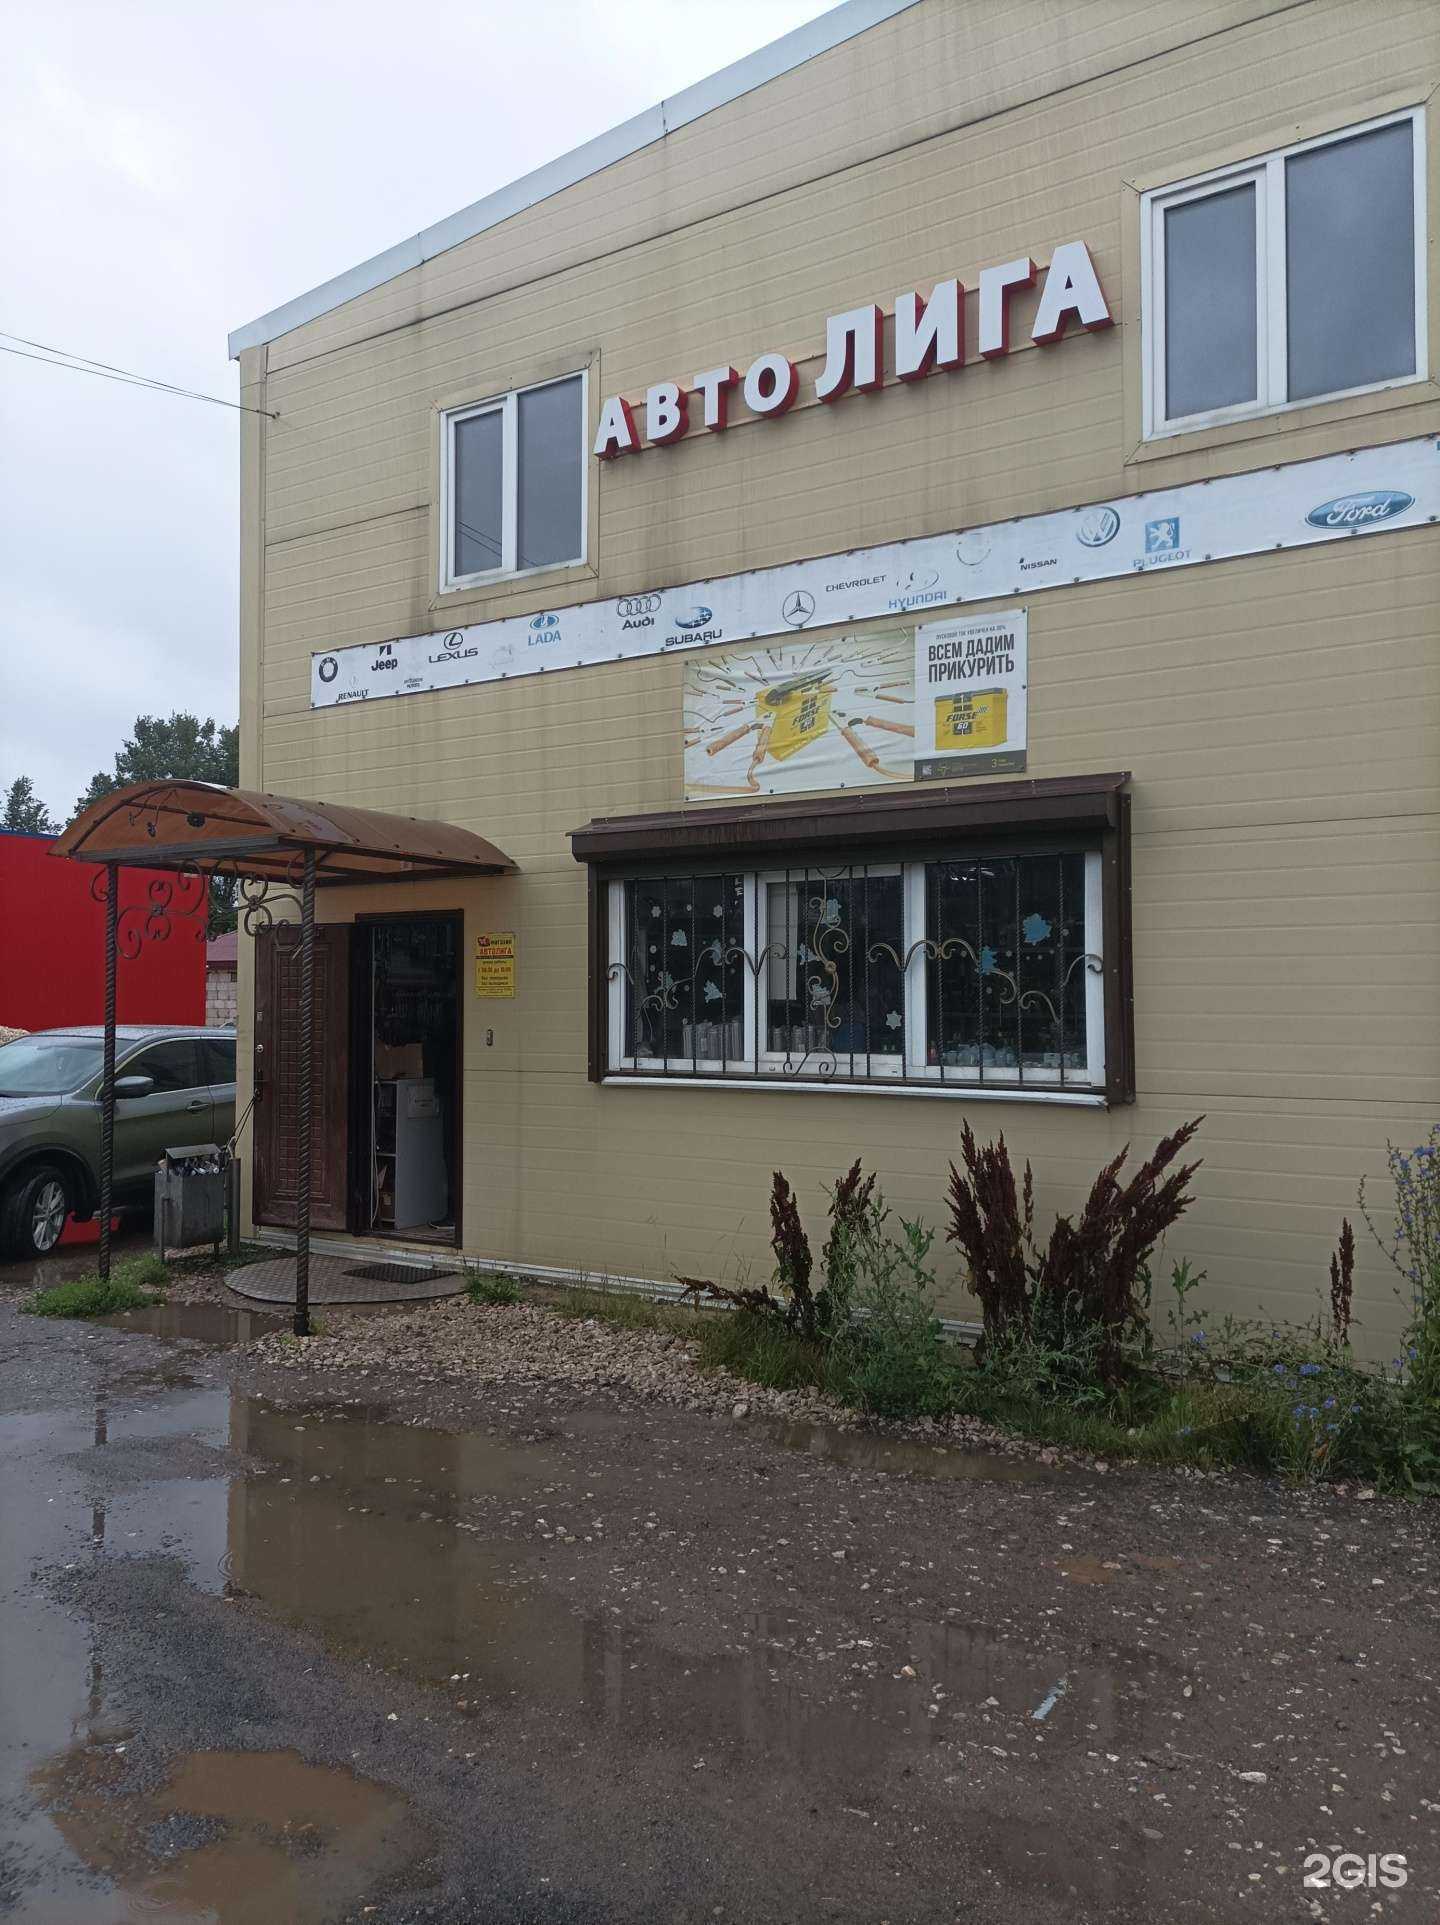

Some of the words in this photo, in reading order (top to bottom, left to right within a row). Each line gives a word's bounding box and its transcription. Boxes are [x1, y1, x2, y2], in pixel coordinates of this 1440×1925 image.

[1326, 495, 1392, 525] Ford
[1020, 558, 1058, 571] NISSAN
[825, 574, 887, 592] CHEVROLET
[888, 590, 948, 609] HYUNDAI
[621, 616, 655, 630] Audi
[527, 629, 562, 646] LADA
[665, 628, 723, 647] SUBARU
[428, 647, 479, 664] LEXUS
[928, 640, 962, 662] ВСЕМ
[965, 633, 1015, 659] ДАДИМ
[371, 658, 398, 672] Jeep
[928, 653, 1015, 684] ПРИКУРИТЬ
[337, 688, 369, 701] RENAULT
